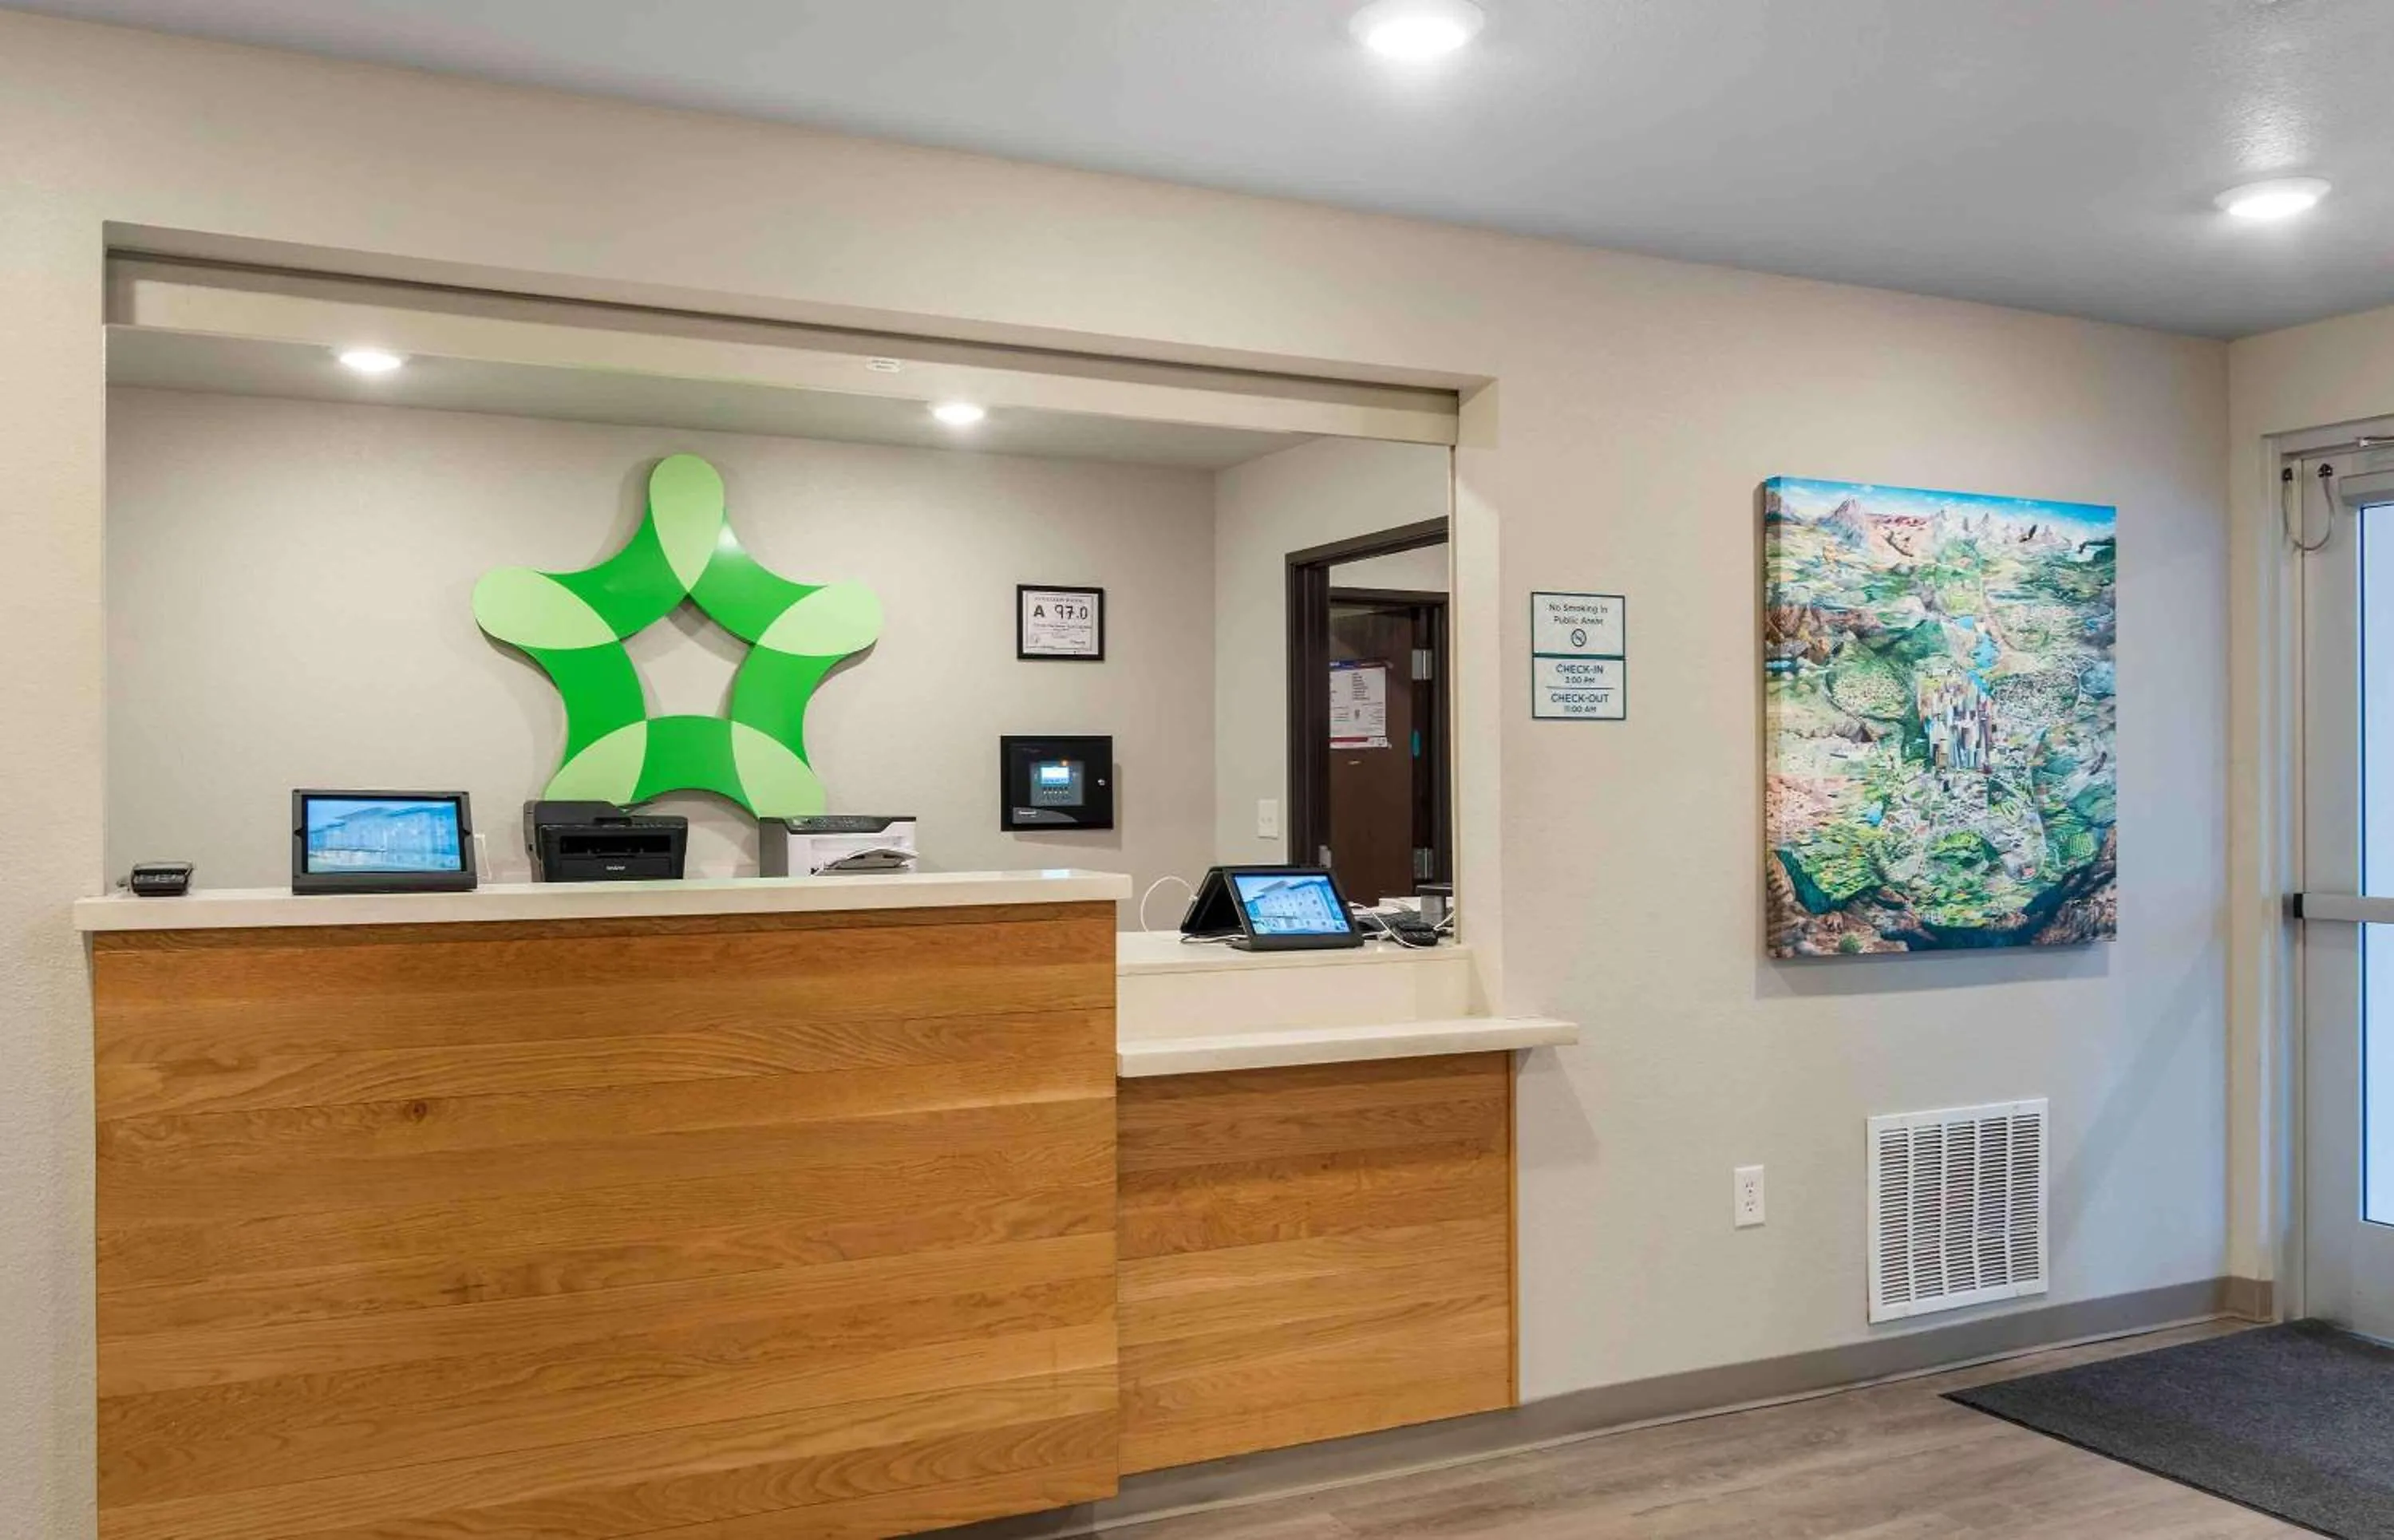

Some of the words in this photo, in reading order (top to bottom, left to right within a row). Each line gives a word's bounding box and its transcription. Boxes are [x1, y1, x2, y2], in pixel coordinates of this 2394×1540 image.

[1033, 604, 1045, 618] A
[1054, 604, 1088, 619] 97.0
[1549, 603, 1562, 612] No
[1563, 604, 1598, 614] Smoking
[1554, 615, 1578, 625] Public
[1555, 663, 1604, 674] CHECK-IN
[1551, 693, 1610, 703] CHECK-OUT
